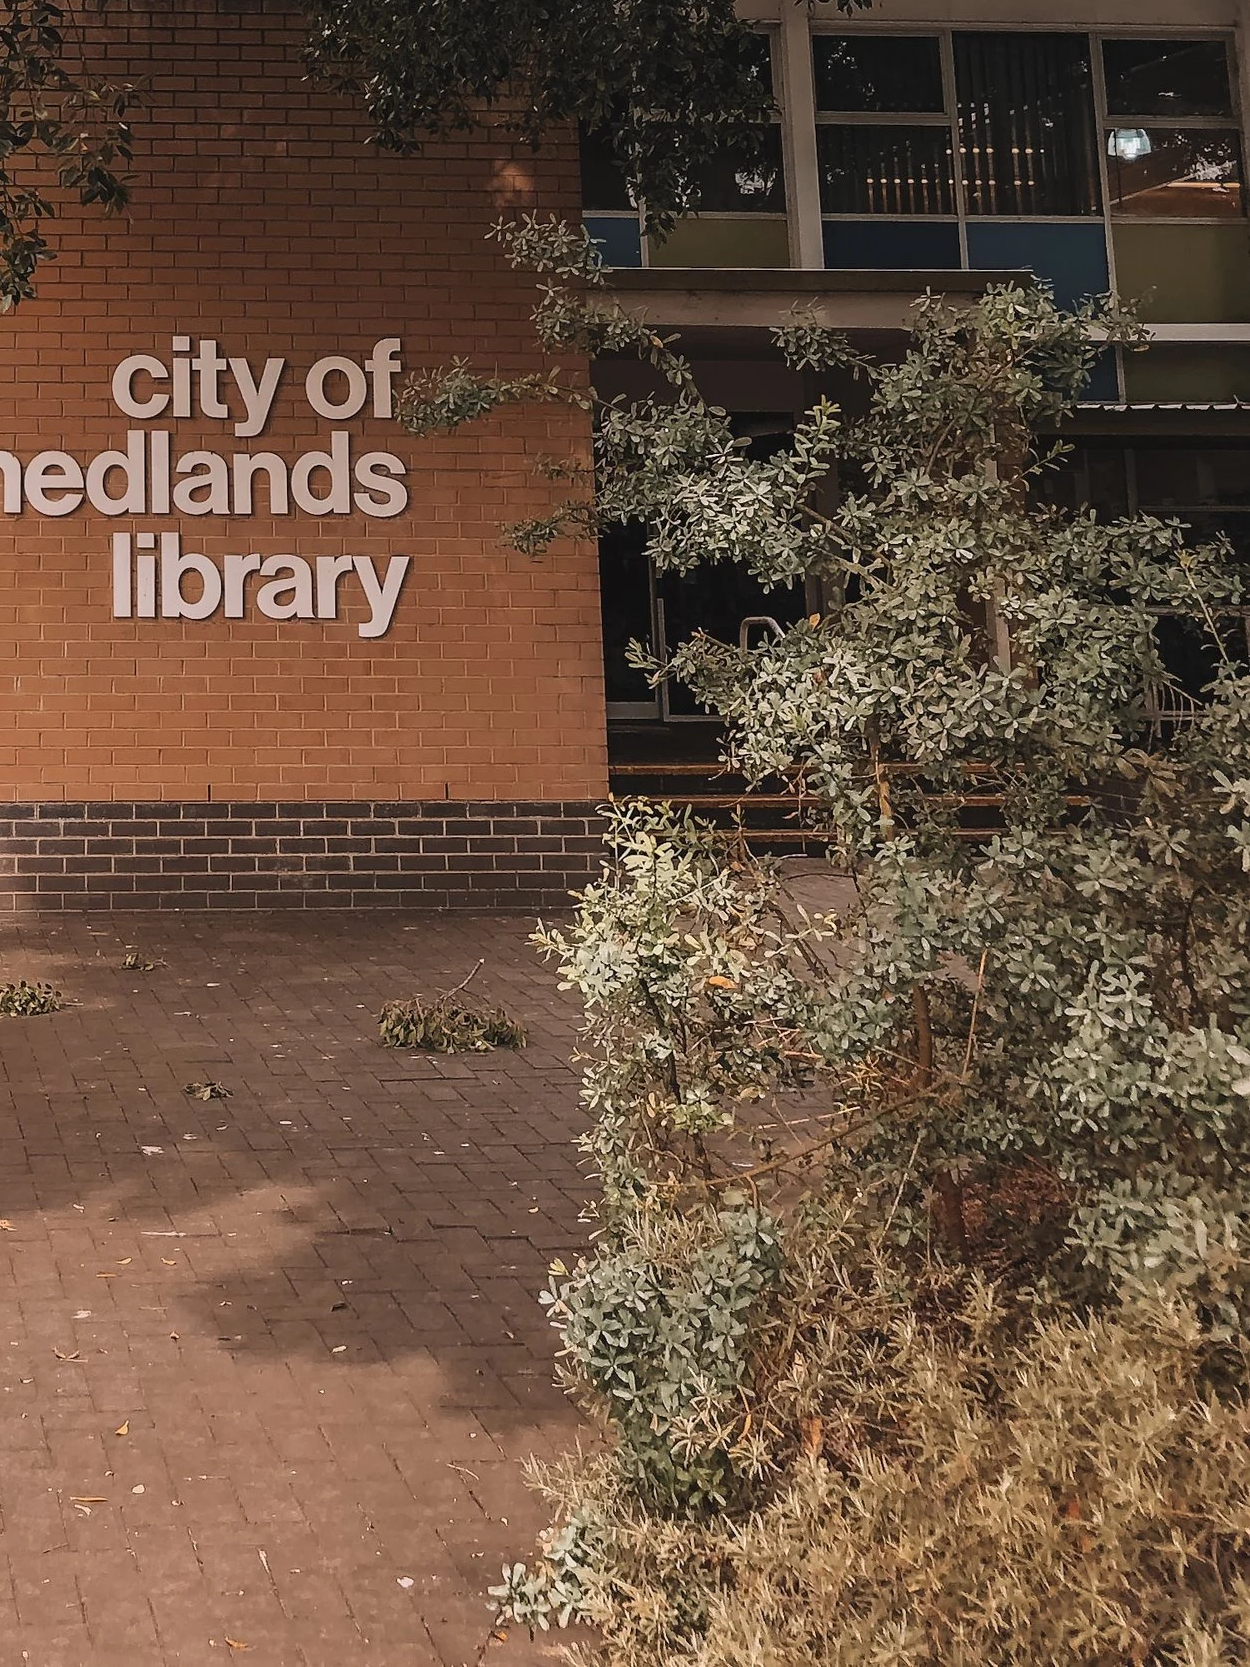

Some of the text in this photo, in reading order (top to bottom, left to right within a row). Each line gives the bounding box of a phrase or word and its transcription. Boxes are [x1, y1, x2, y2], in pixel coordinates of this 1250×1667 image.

[111, 336, 402, 437] city of
[112, 532, 410, 638] library
